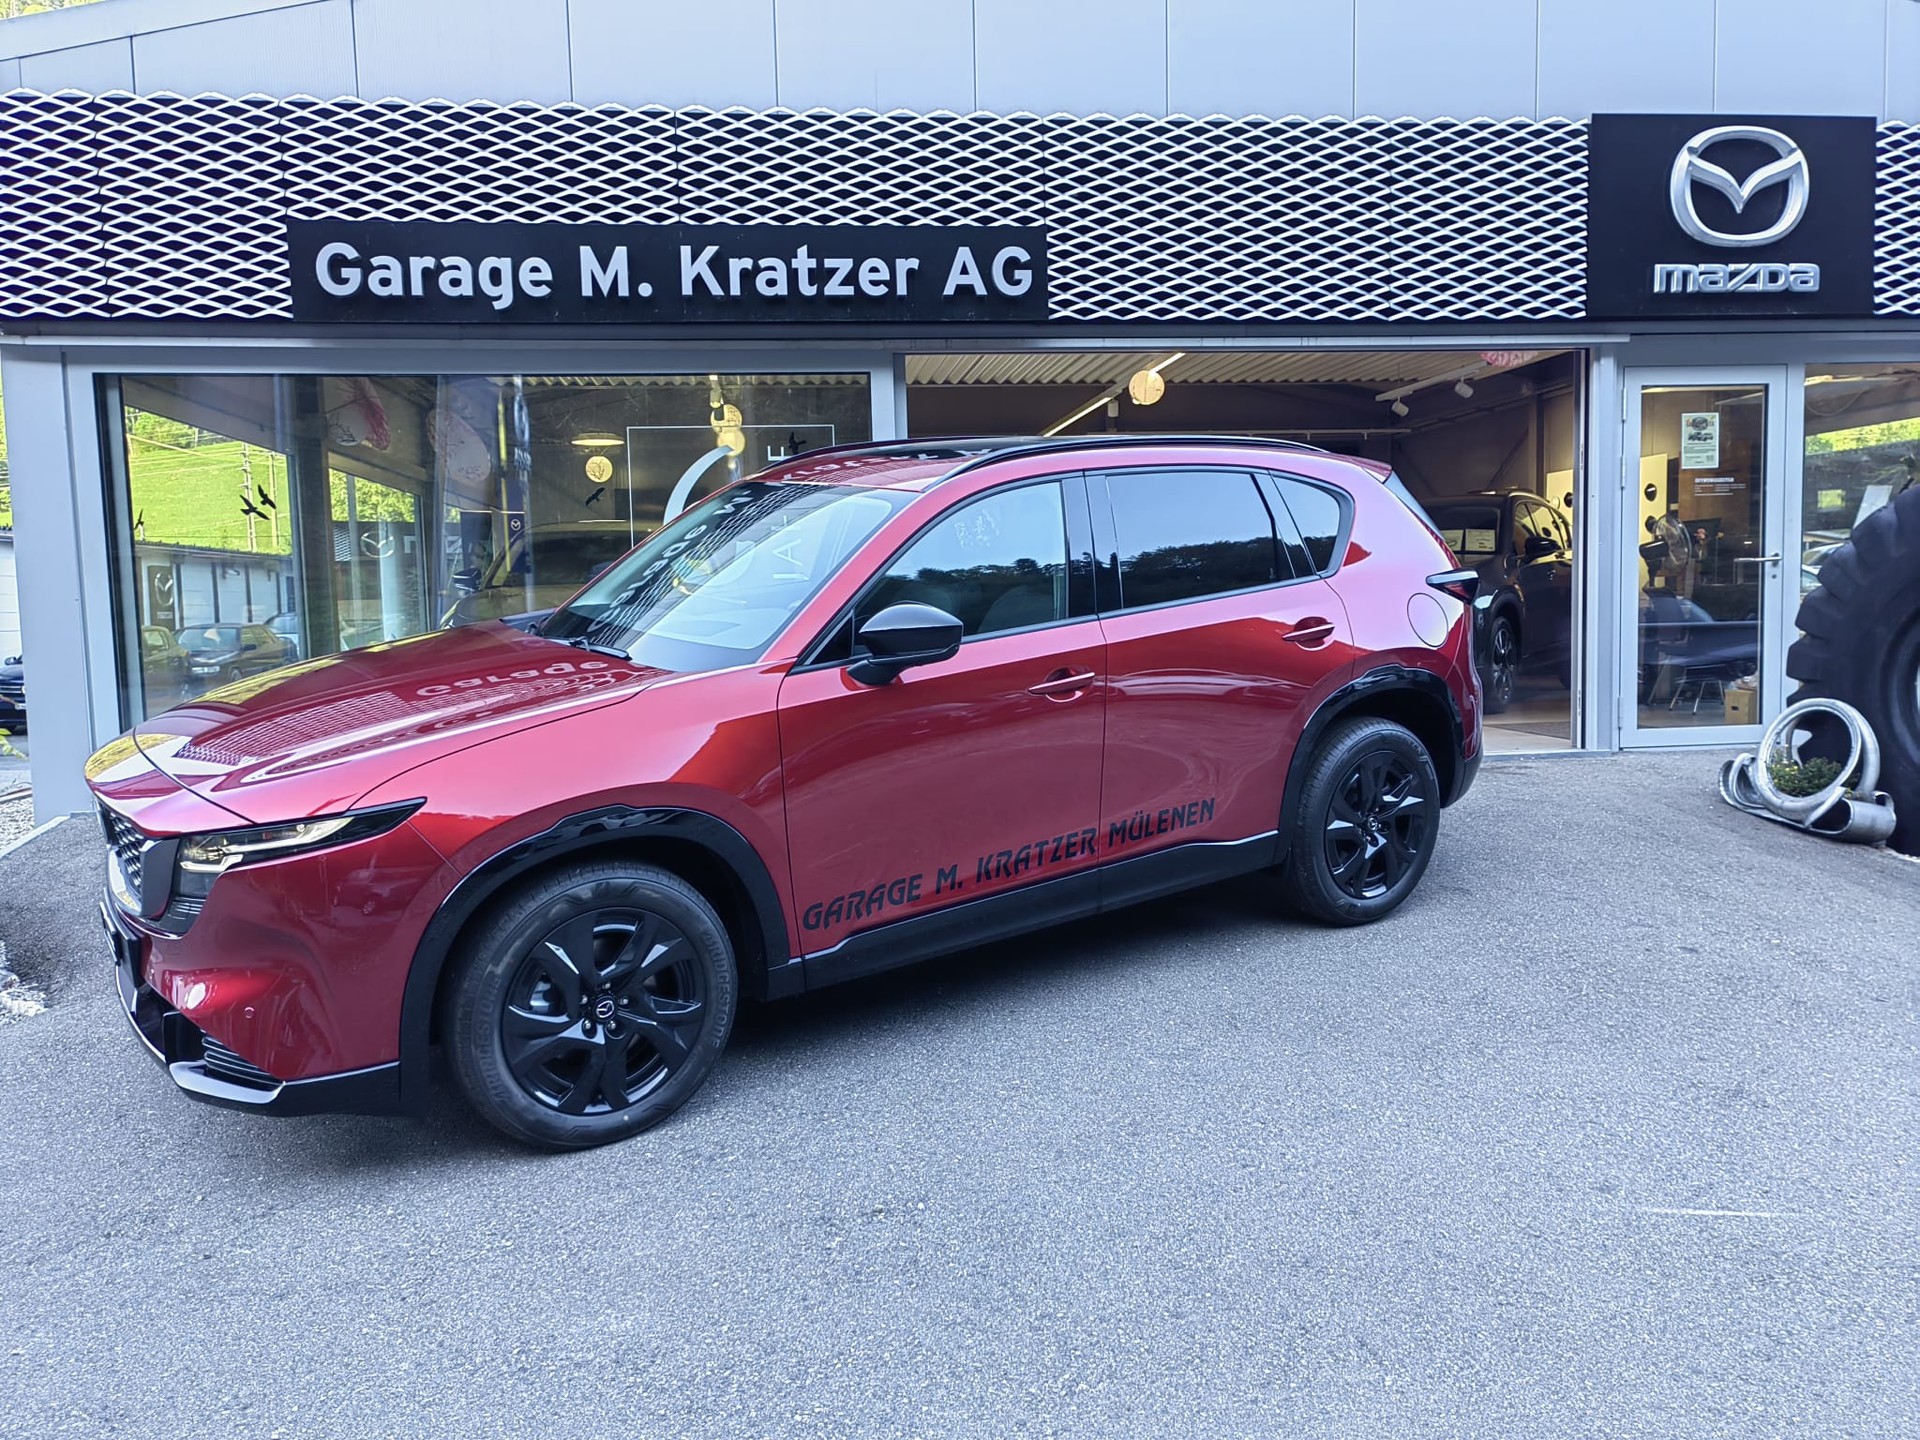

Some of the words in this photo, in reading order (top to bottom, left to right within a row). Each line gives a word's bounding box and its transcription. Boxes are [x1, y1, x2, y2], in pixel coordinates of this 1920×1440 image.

[314, 241, 553, 310] Garage
[579, 245, 653, 298] M.
[680, 244, 919, 297] Kratzer
[942, 245, 1033, 297] AG
[802, 873, 924, 931] GARAGE
[934, 864, 963, 895] M.
[976, 827, 1098, 884] KRATZER
[1108, 796, 1216, 848] MÜLENEN
